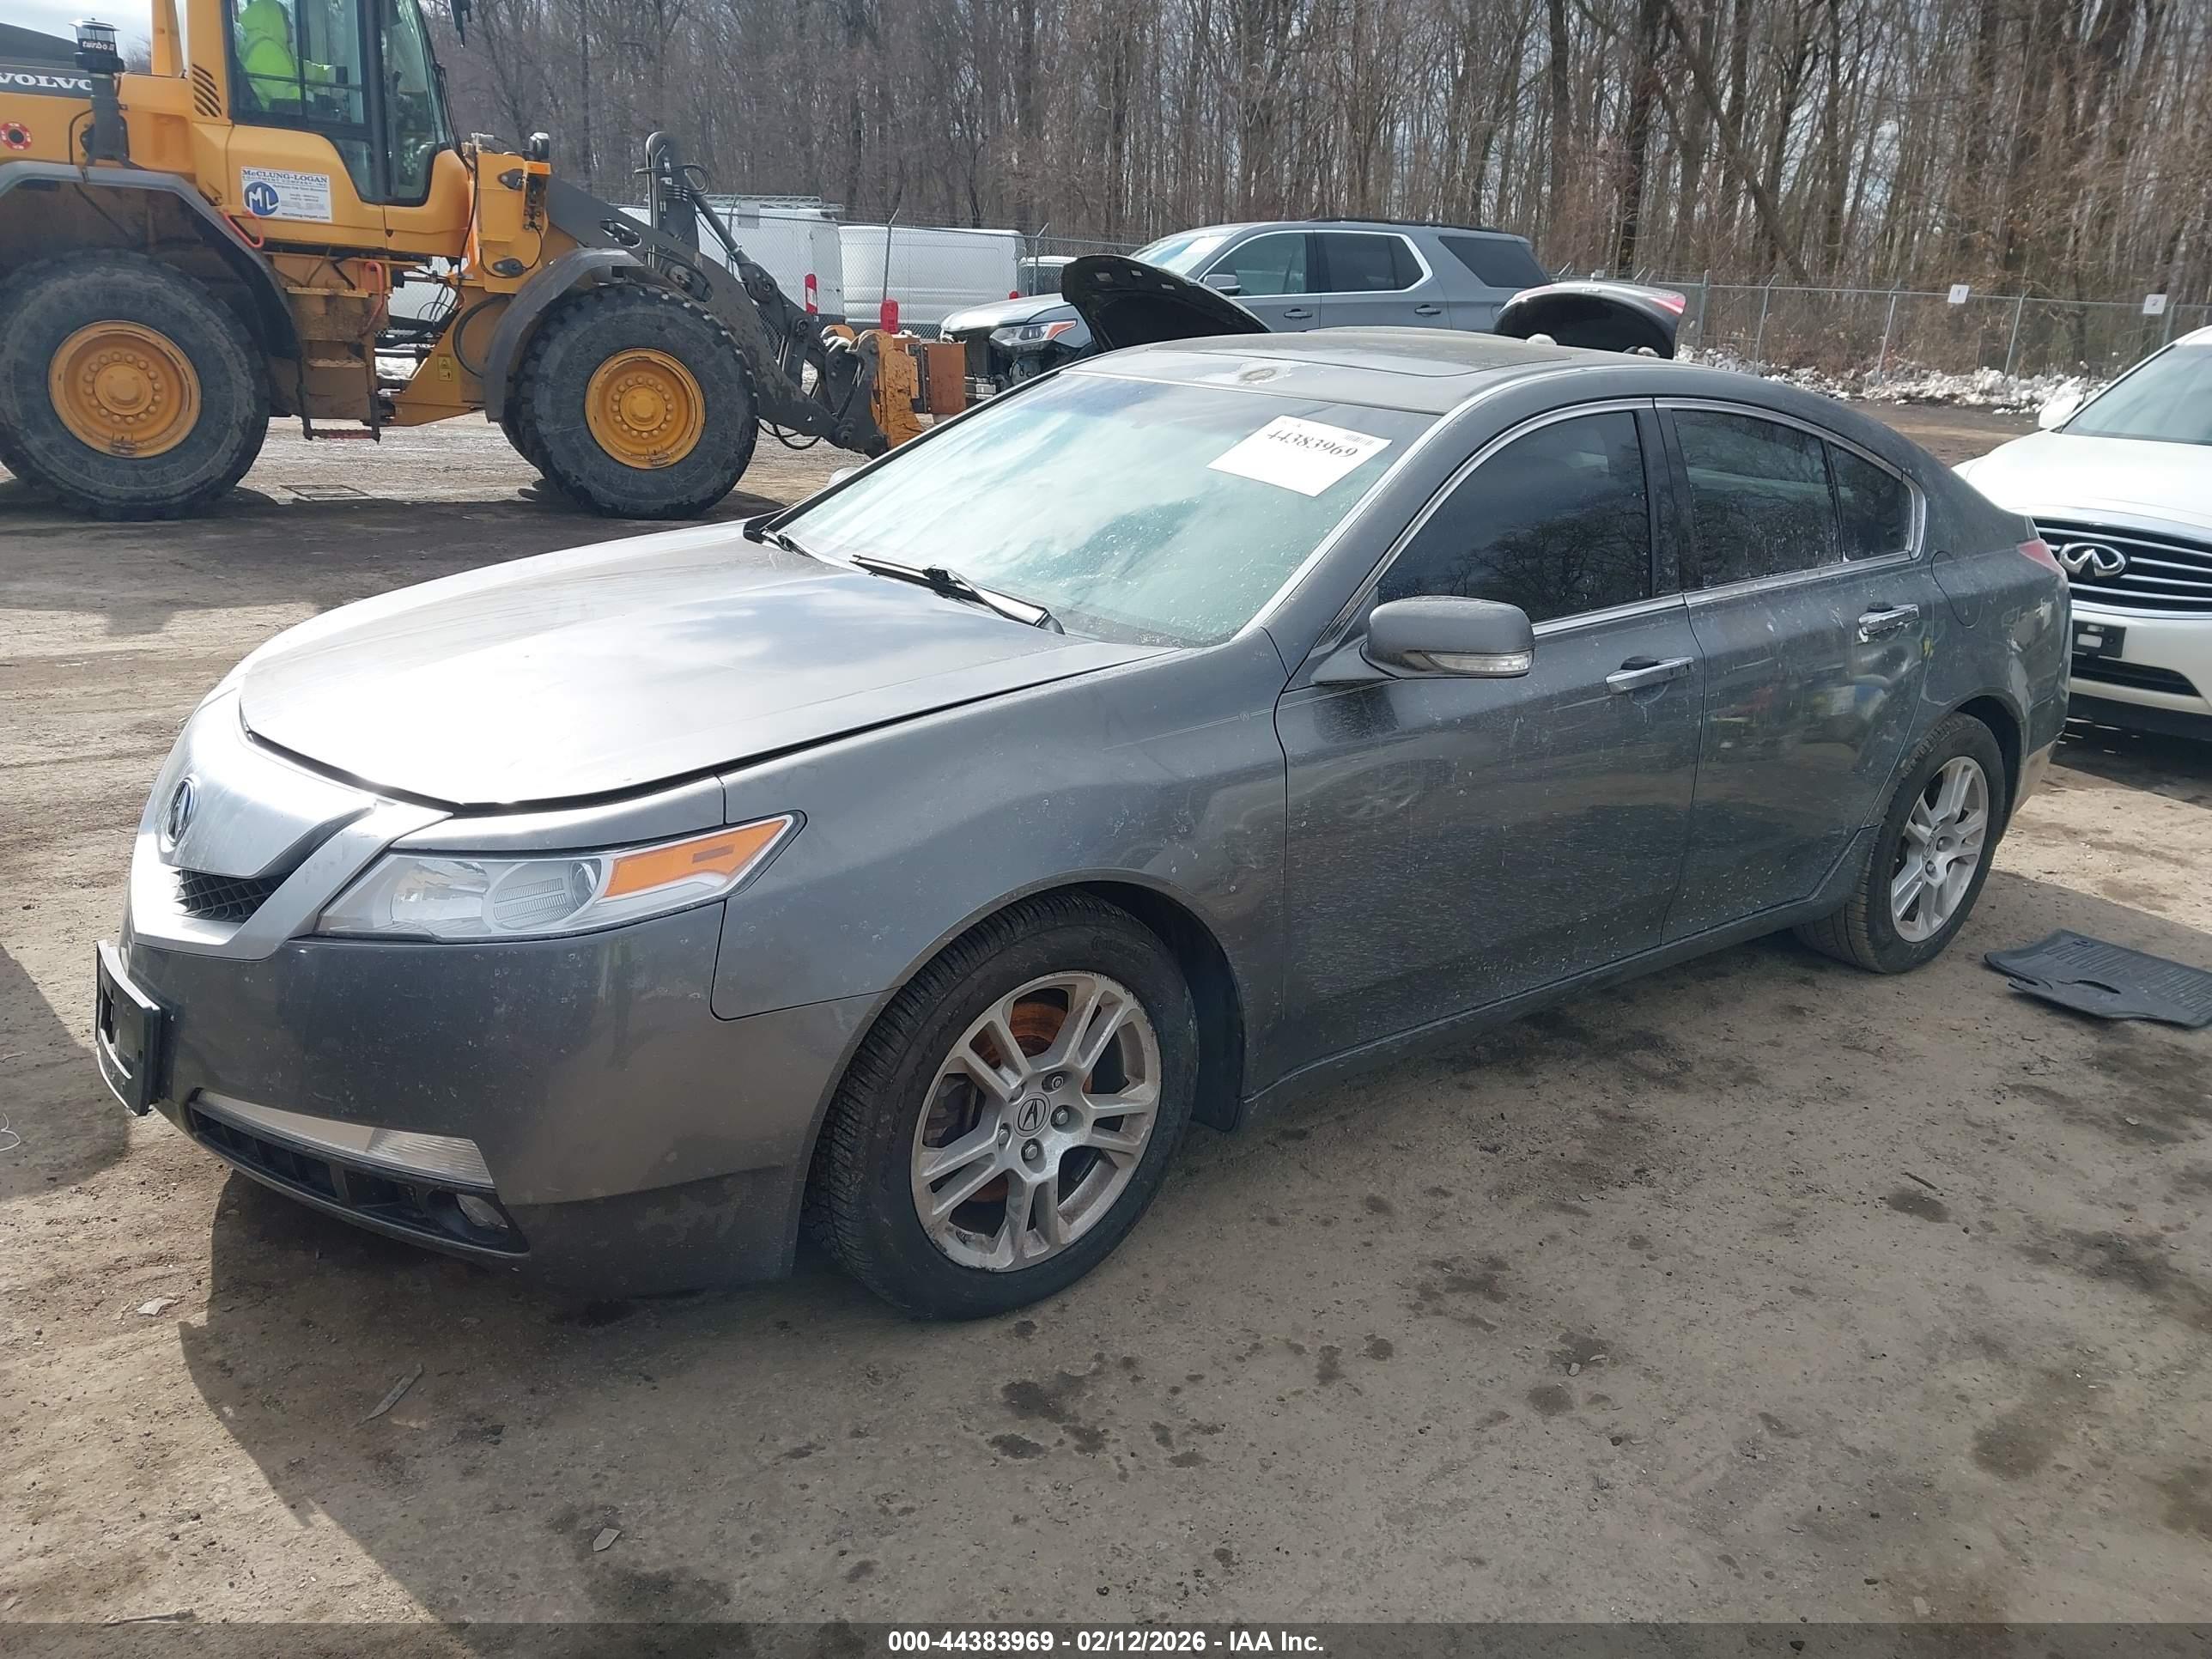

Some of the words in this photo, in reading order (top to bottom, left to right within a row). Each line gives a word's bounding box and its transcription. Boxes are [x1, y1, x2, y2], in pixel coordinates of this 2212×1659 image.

[82, 40, 108, 50] turbo
[248, 186, 279, 211] ML
[1267, 429, 1358, 458] 44383969
